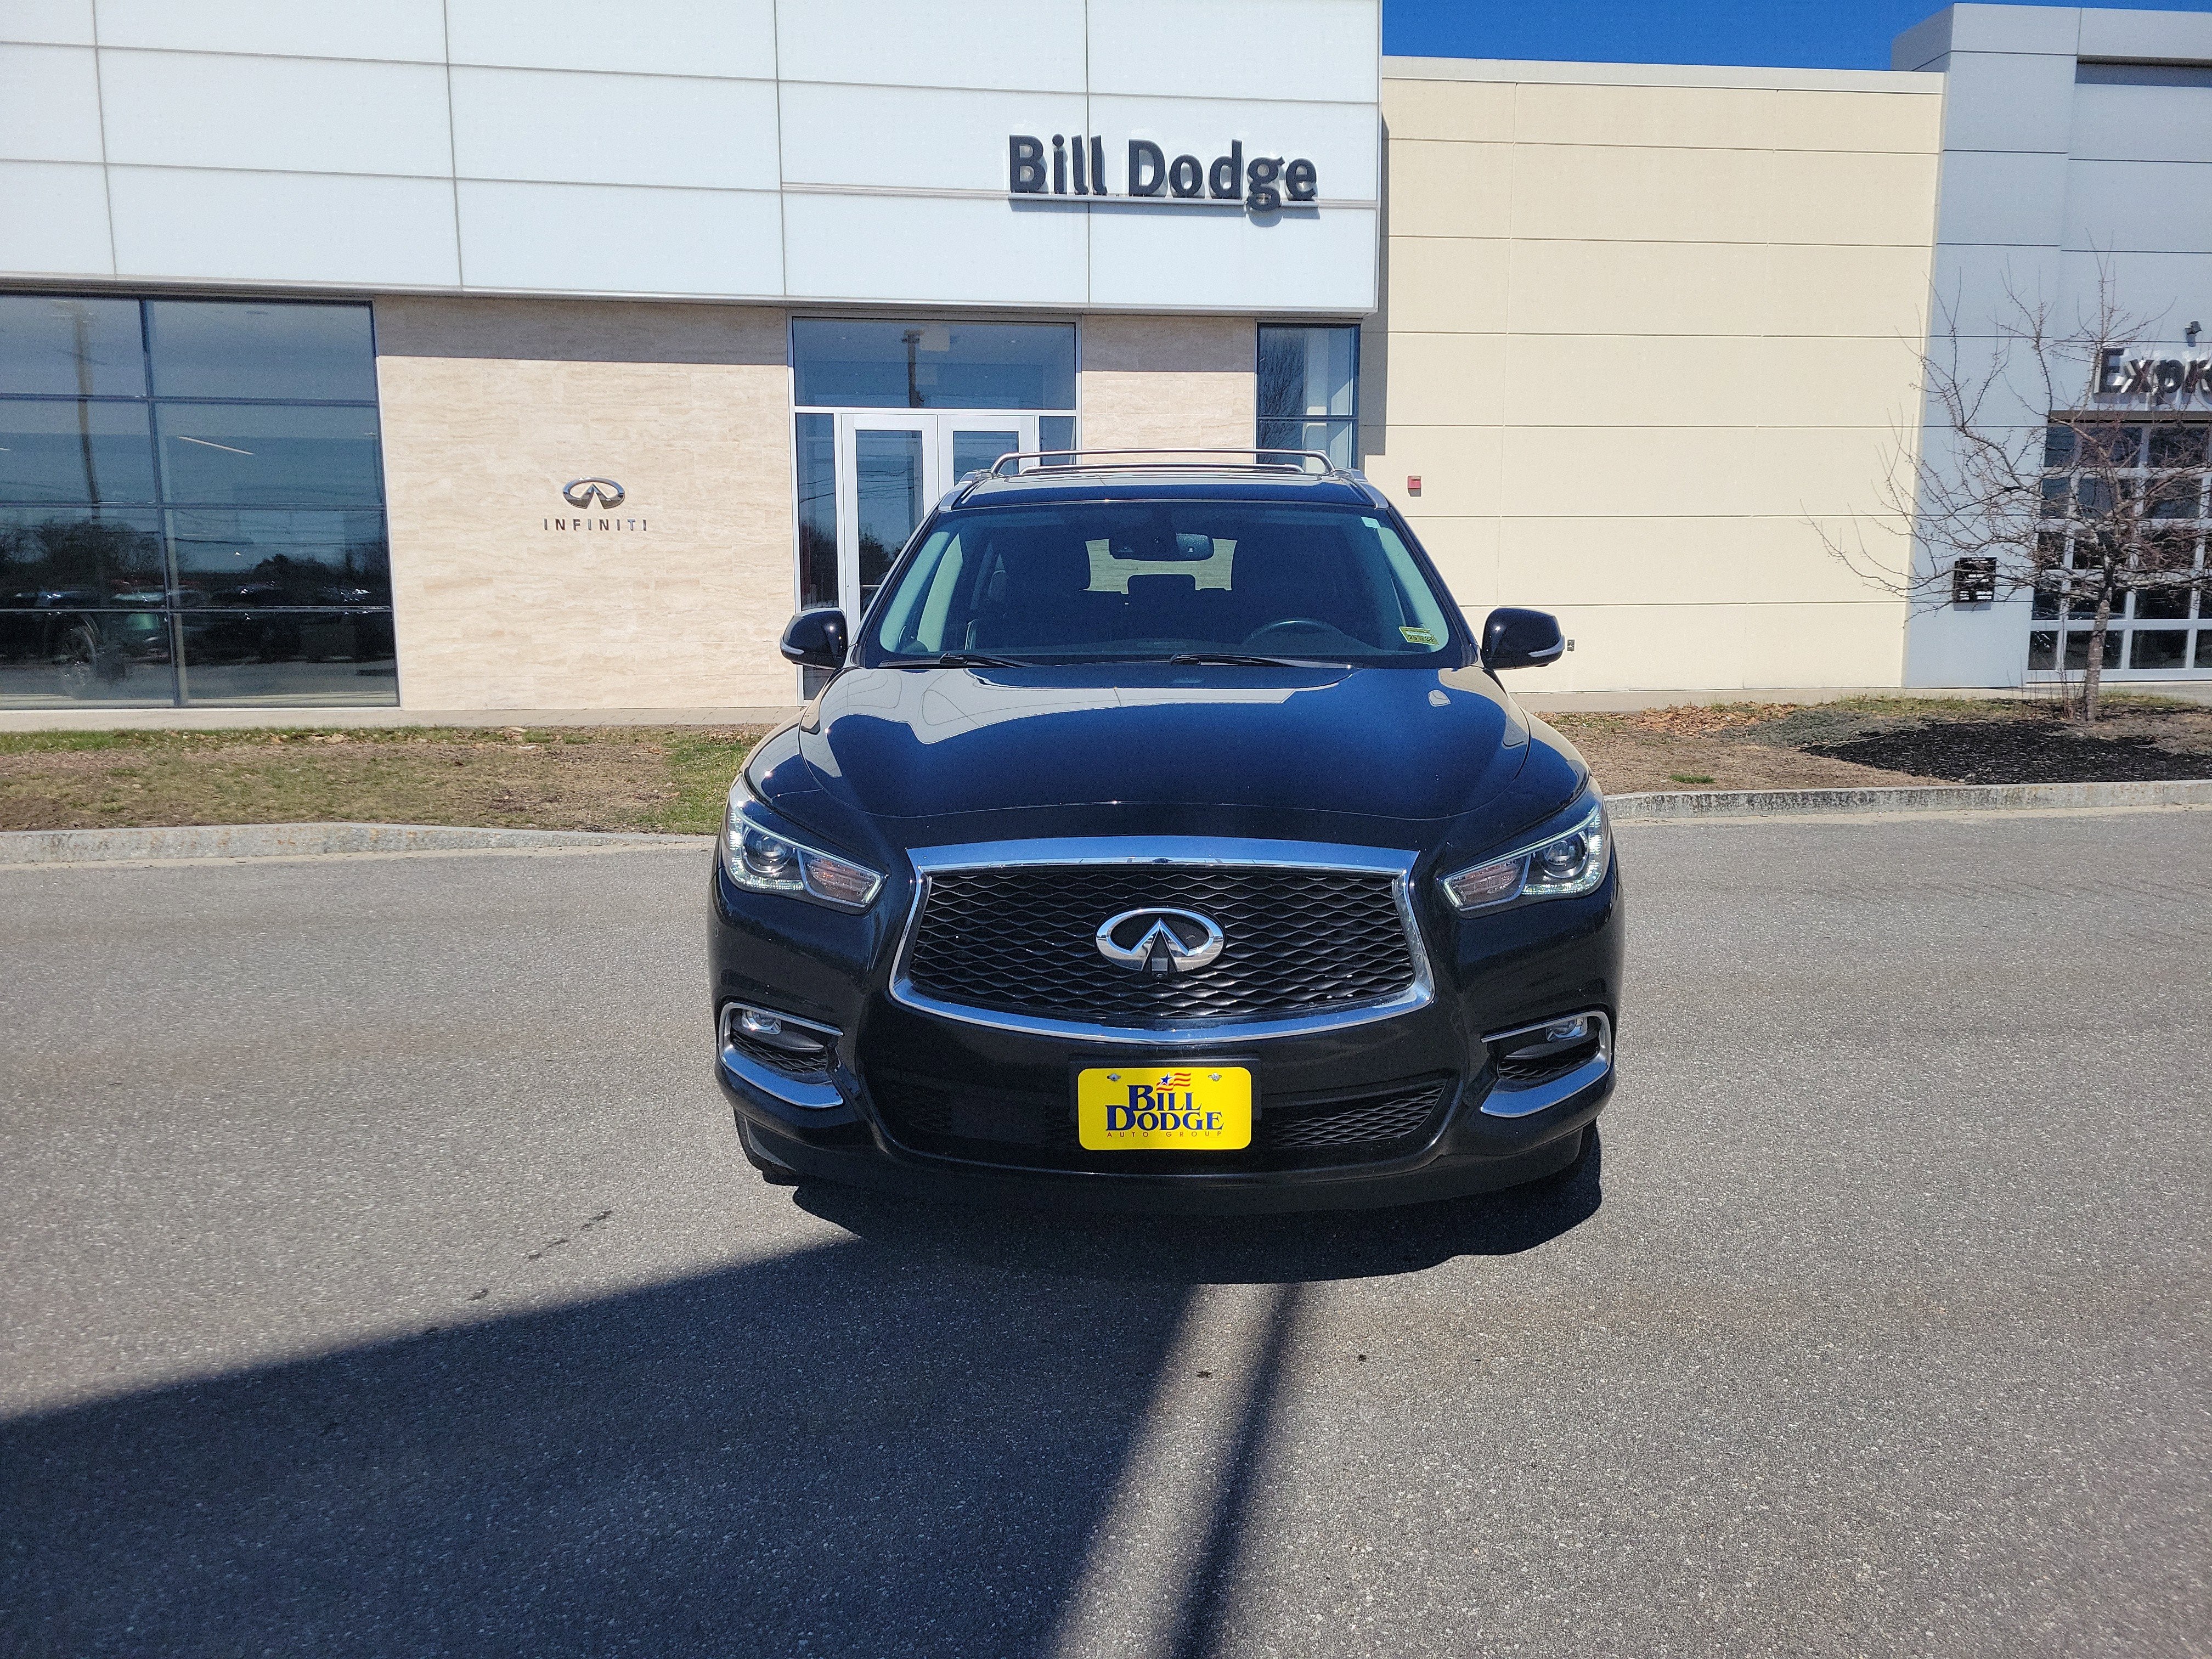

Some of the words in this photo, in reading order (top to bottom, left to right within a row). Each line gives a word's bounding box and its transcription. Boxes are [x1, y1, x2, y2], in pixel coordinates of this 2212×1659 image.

[1009, 133, 1107, 195] Bill
[1128, 138, 1317, 212] Dodge
[543, 518, 647, 531] INFINITI
[1127, 1084, 1201, 1111] BILL
[1105, 1105, 1224, 1131] DODGE
